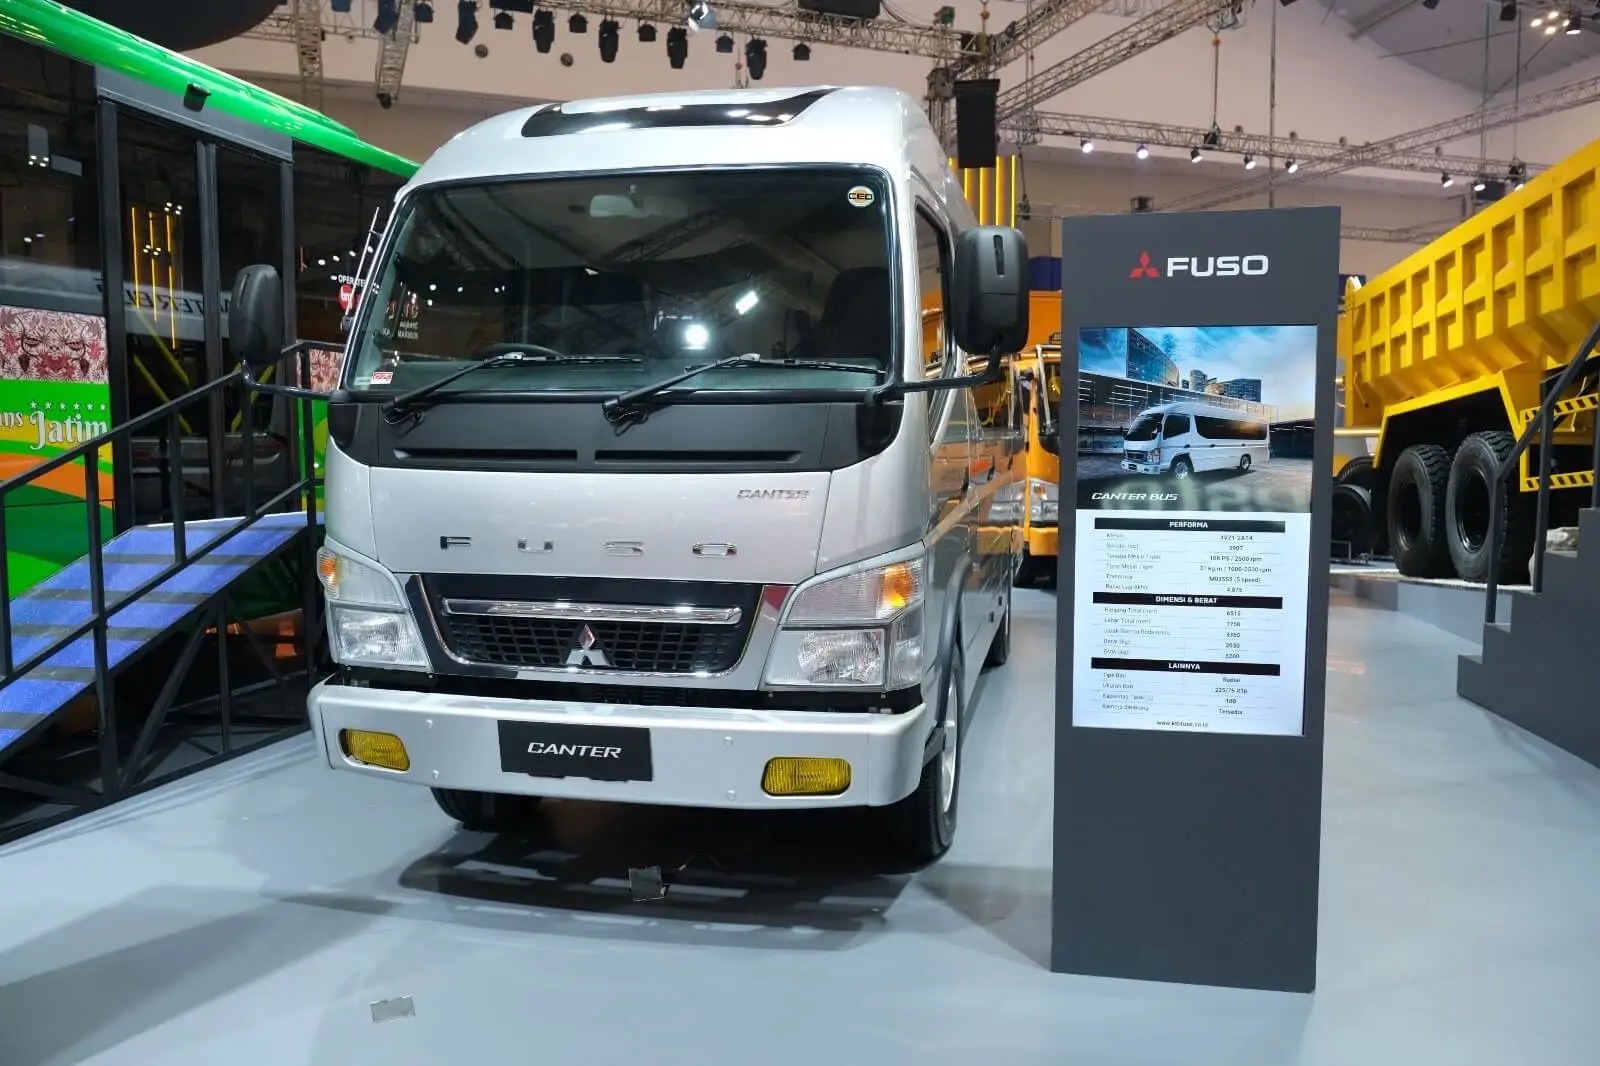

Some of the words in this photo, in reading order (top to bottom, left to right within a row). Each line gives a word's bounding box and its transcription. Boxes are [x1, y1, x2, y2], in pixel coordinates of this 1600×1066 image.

[1166, 254, 1269, 278] FUSO
[29, 409, 109, 450] Jatim
[737, 488, 810, 500] CANTER
[1091, 492, 1147, 501] CANTER
[1149, 493, 1179, 501] BUS
[1169, 521, 1209, 529] PERFORMA
[439, 535, 738, 559] FUSO
[1155, 595, 1186, 603] DIMENSI
[1168, 662, 1201, 670] LAINNYA
[527, 741, 622, 759] CANTER
